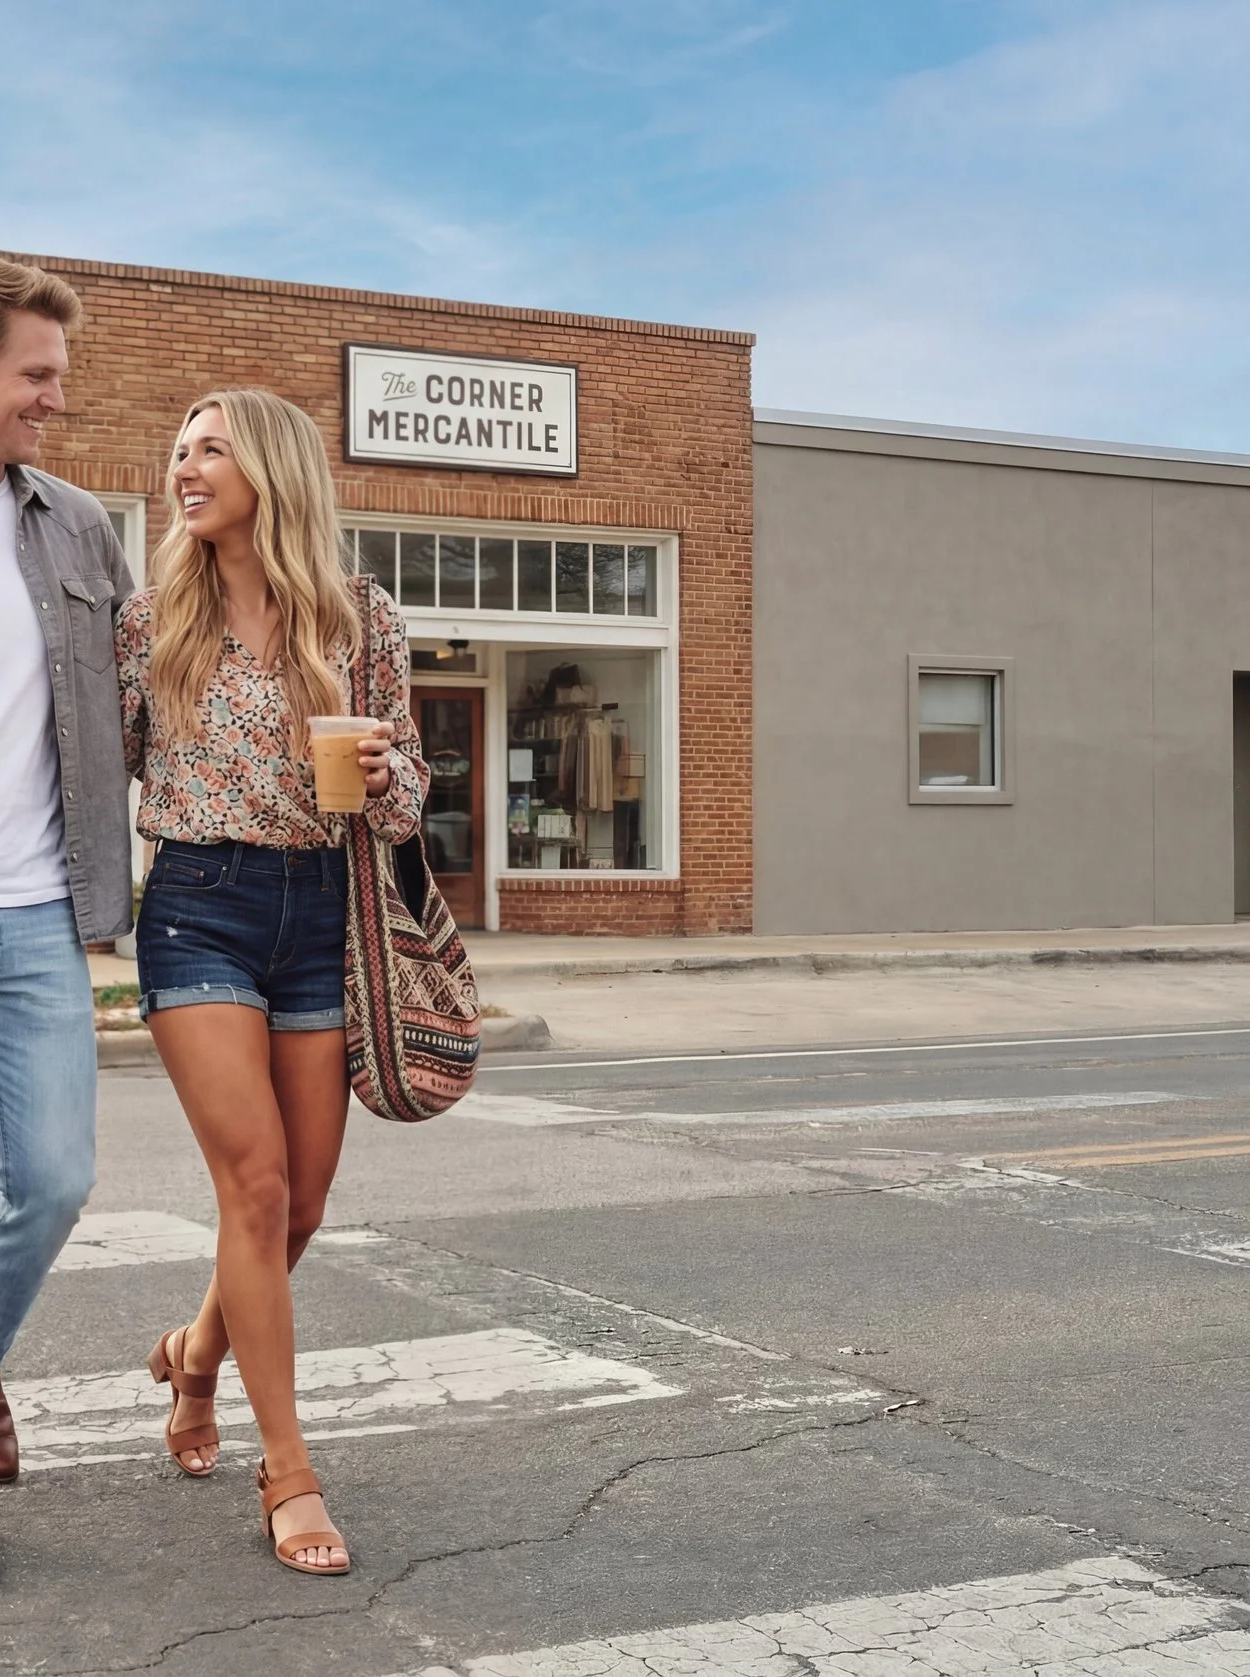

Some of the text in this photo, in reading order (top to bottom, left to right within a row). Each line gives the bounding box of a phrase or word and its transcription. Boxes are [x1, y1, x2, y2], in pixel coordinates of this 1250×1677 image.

[381, 371, 543, 412] The CORNER
[368, 409, 559, 453] MERCANTILE
